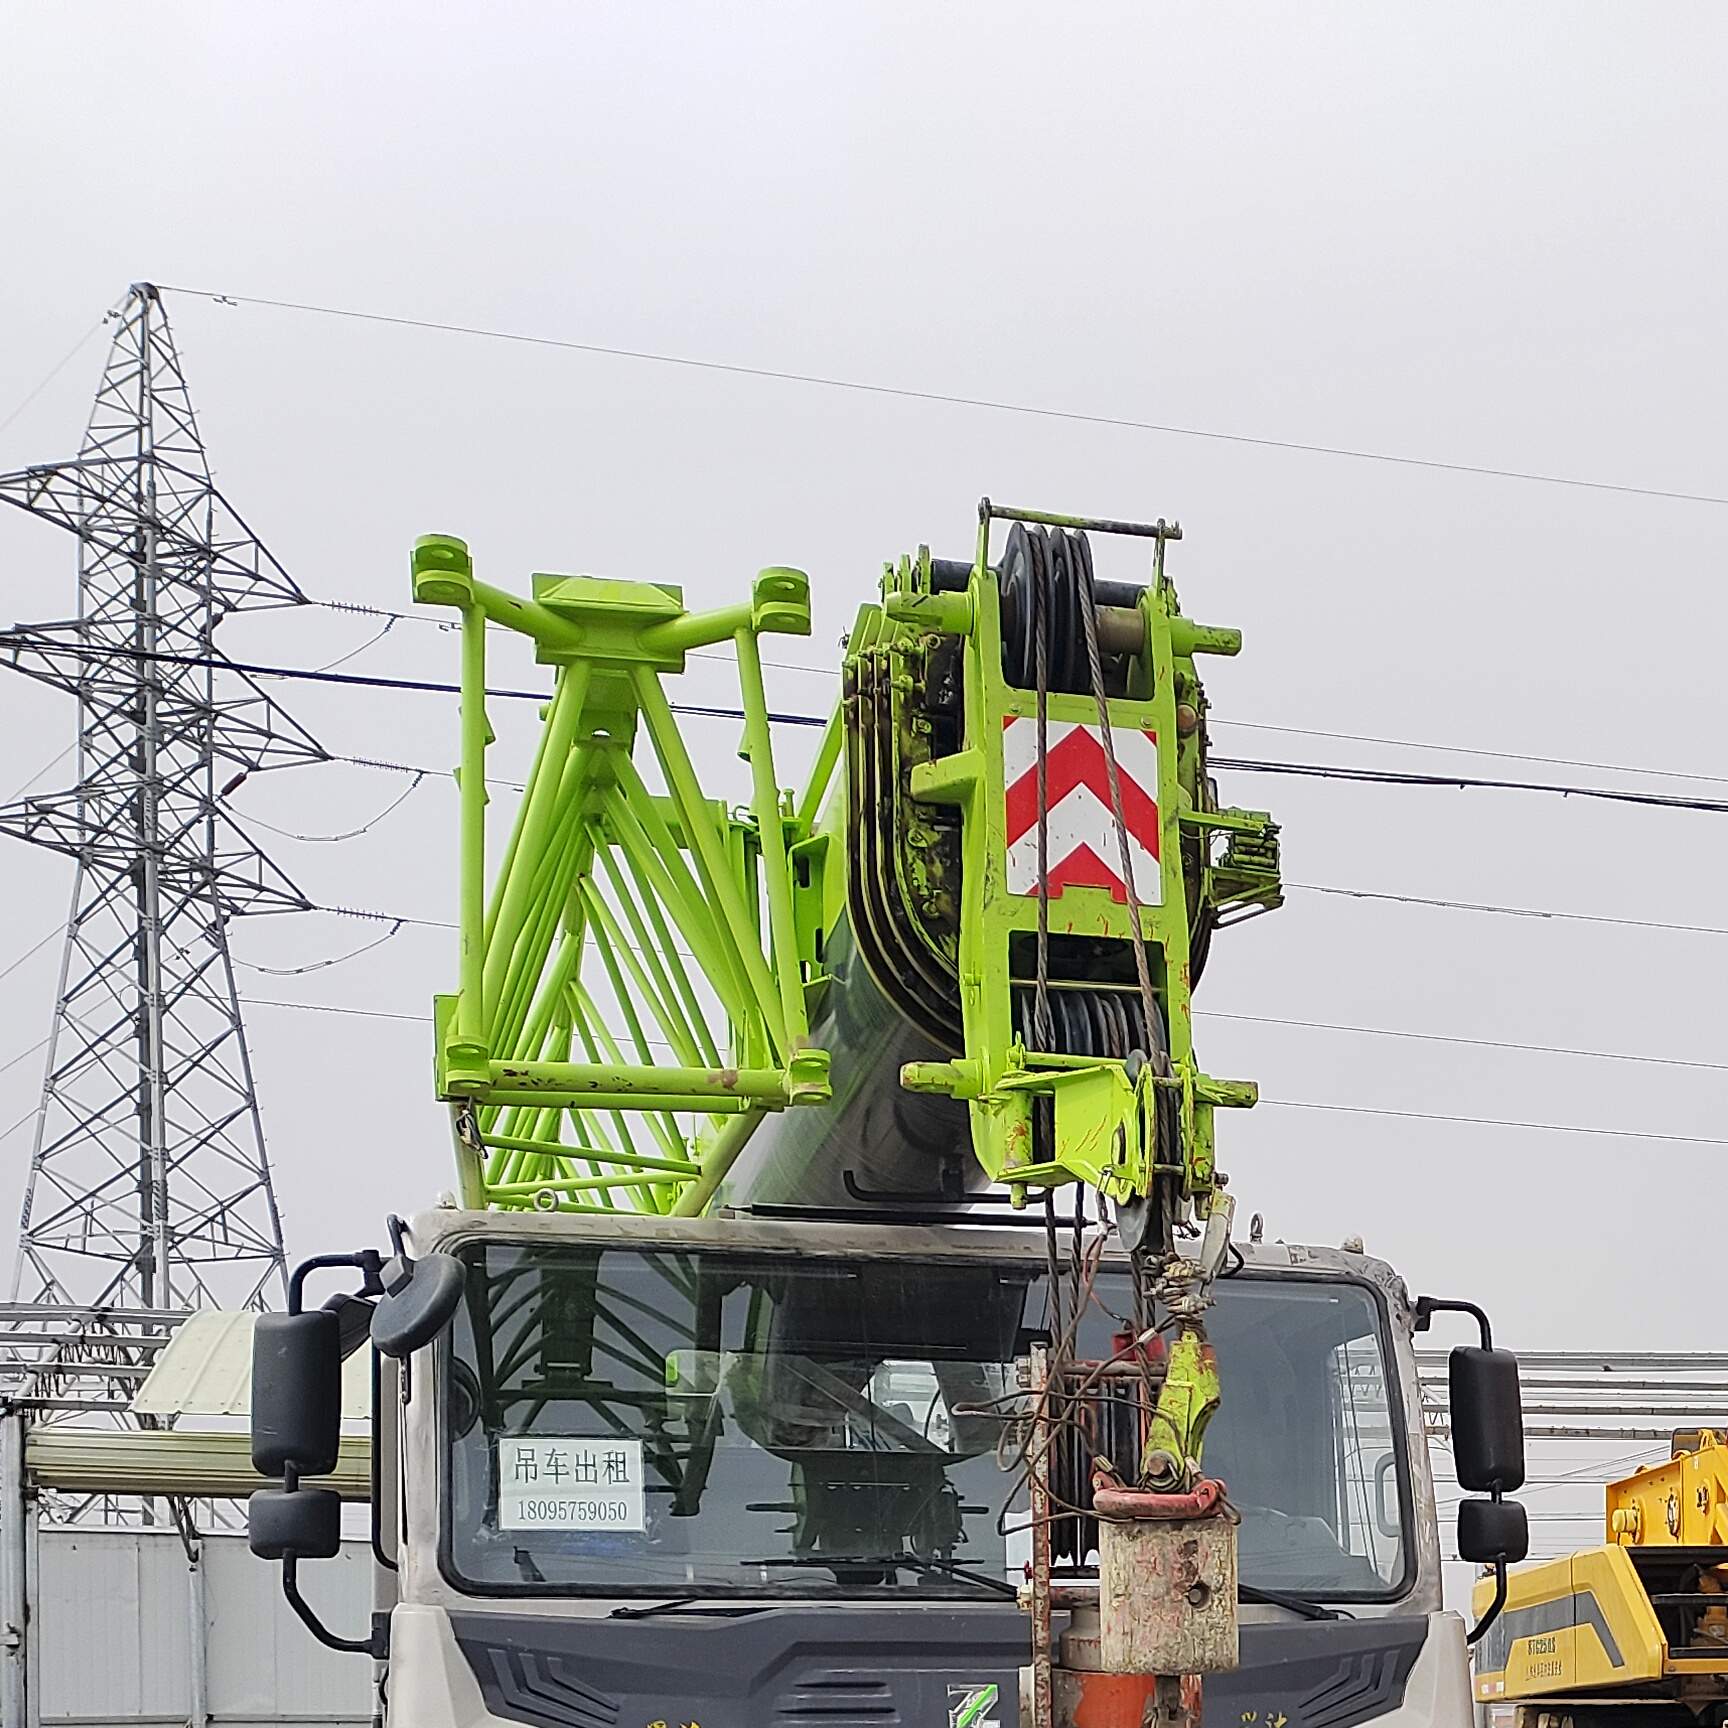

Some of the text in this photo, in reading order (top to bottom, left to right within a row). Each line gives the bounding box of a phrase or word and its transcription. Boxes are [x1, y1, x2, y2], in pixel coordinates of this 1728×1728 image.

[514, 1447, 631, 1485] 吊车出租
[518, 1500, 628, 1521] 18095759050
